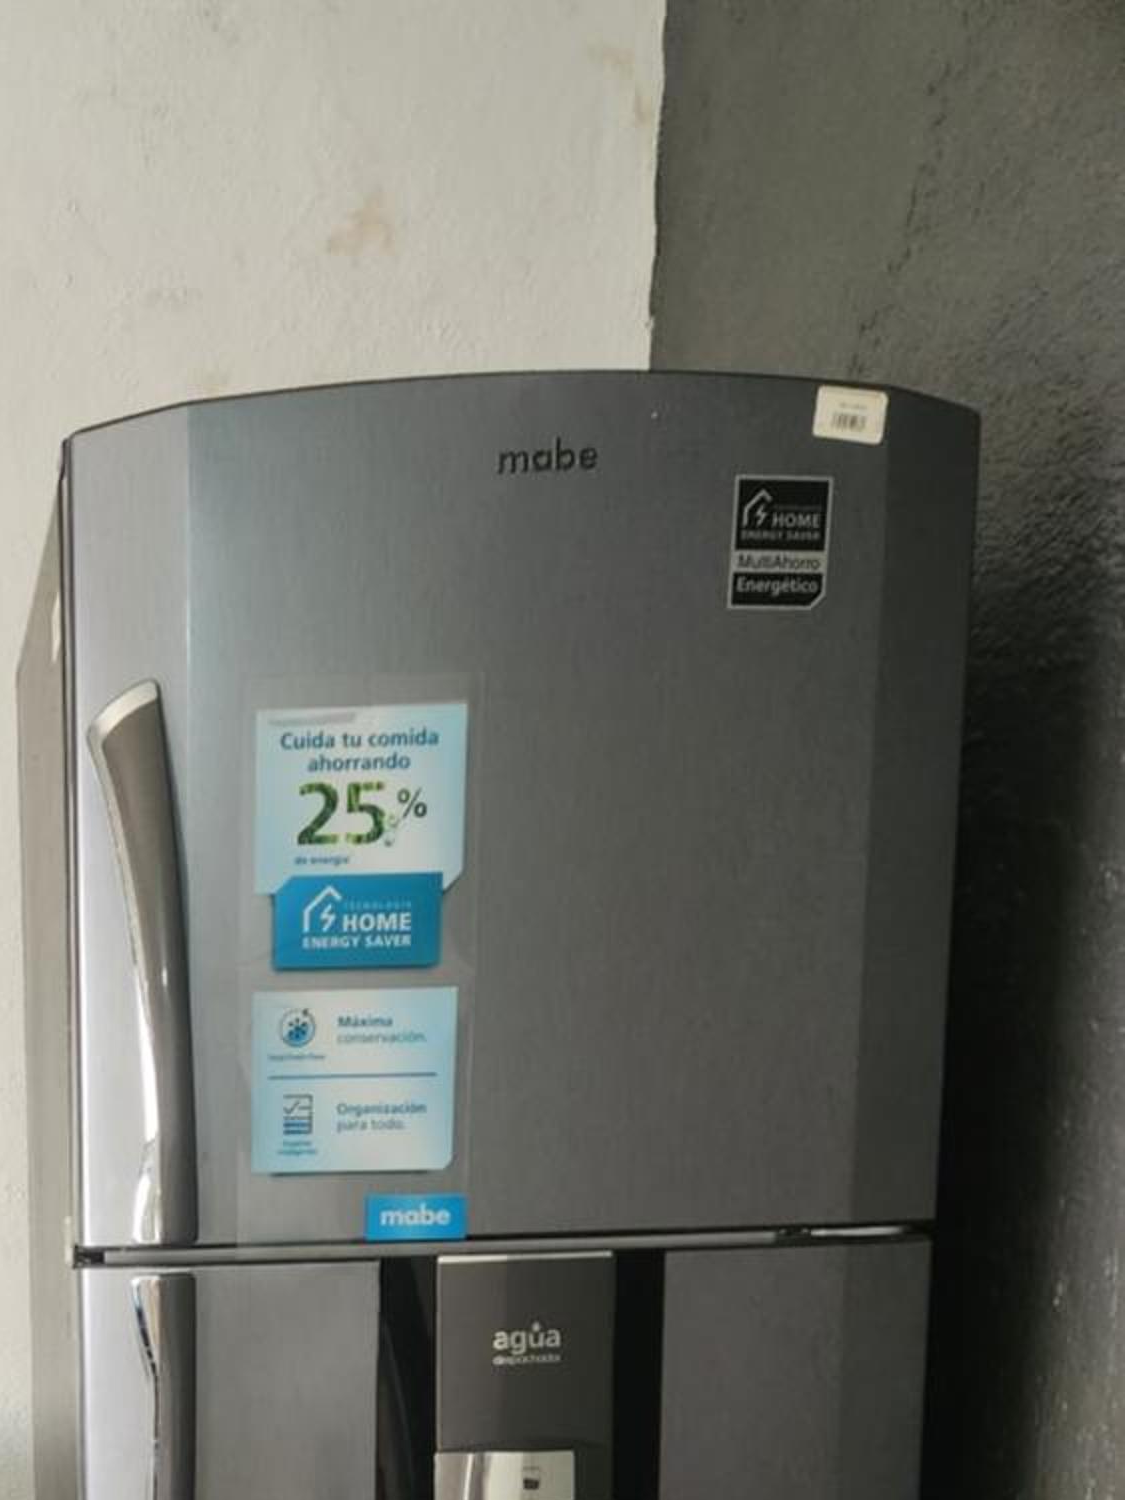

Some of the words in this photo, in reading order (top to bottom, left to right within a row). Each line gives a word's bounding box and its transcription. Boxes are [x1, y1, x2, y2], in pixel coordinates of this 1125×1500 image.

[498, 437, 599, 475] mabe
[772, 512, 820, 529] HOME
[736, 576, 819, 597] Energético
[280, 731, 335, 751] Cuida
[342, 731, 362, 748] tu
[368, 727, 439, 747] comida
[307, 753, 411, 772] ahorrando
[342, 912, 412, 933] HOME
[302, 936, 361, 949] ENERGY
[364, 934, 412, 947] SAVER
[338, 1015, 393, 1027] Máxima
[337, 1102, 427, 1116] Organización
[337, 1120, 368, 1133] para
[379, 1203, 452, 1226] mabe
